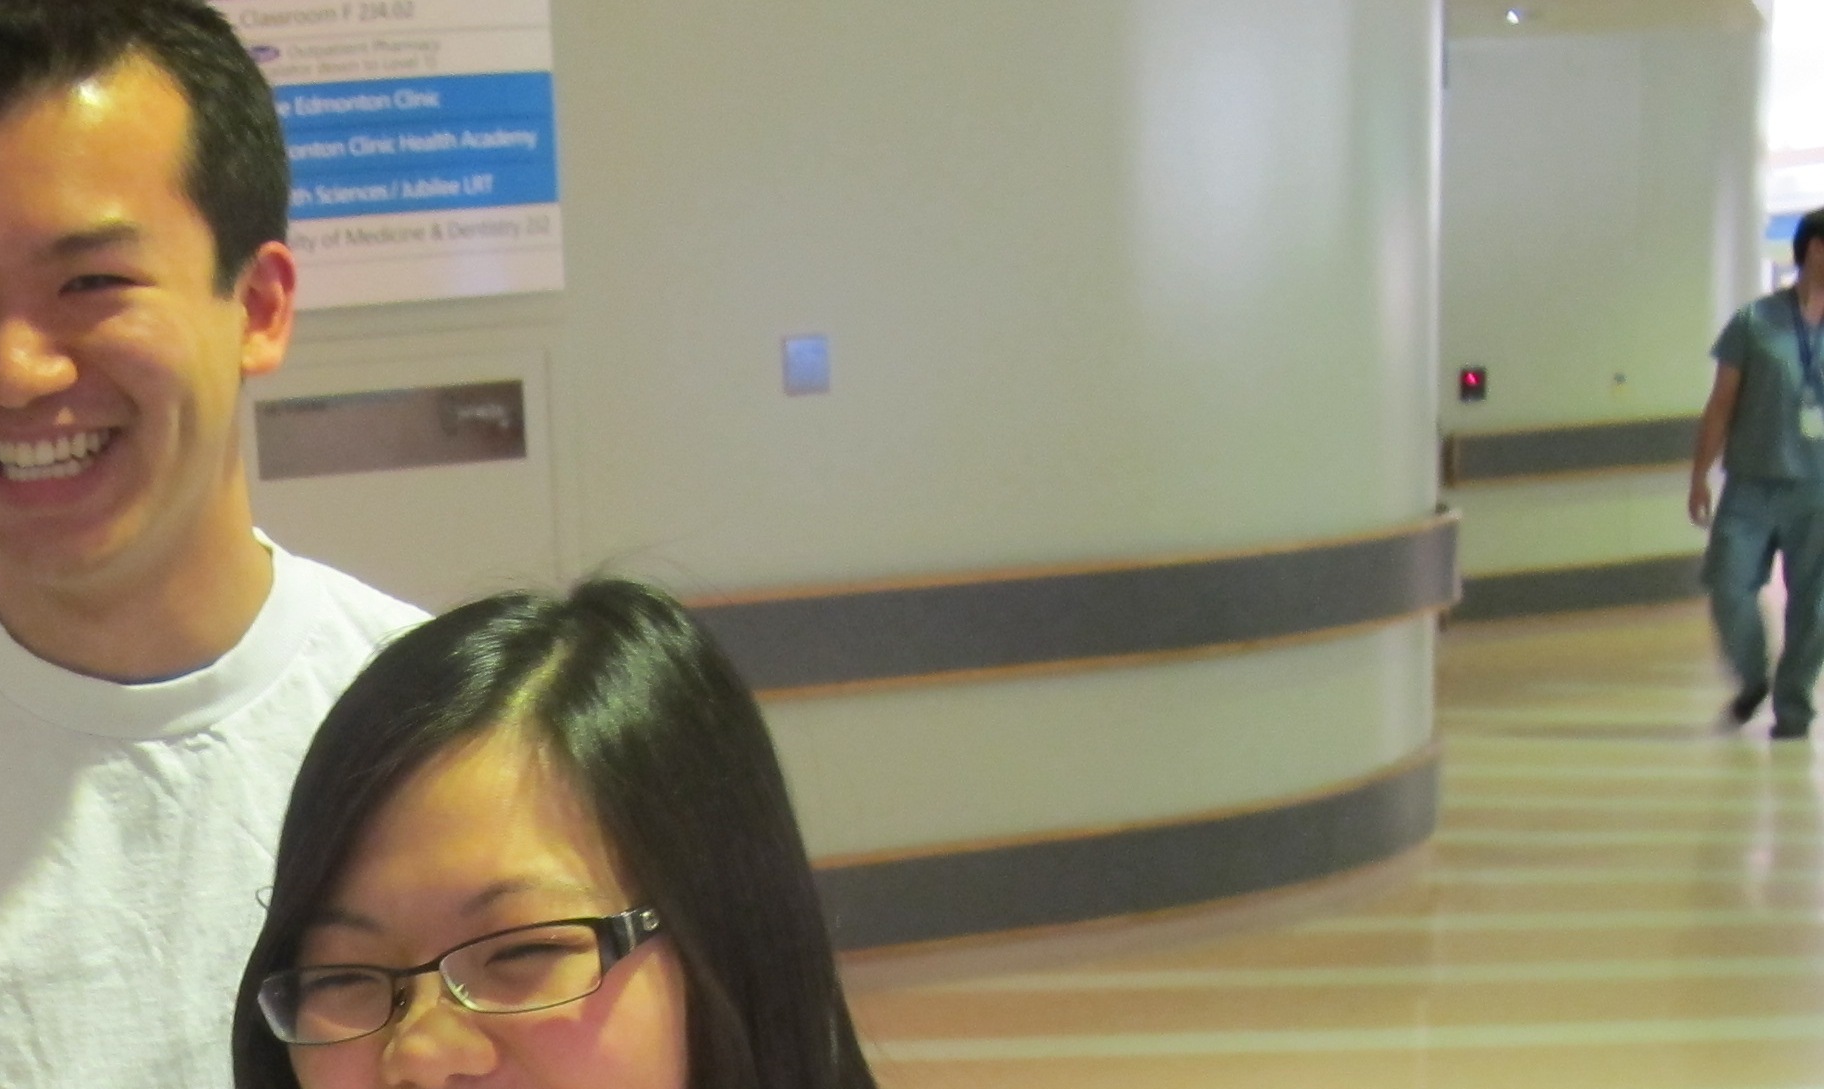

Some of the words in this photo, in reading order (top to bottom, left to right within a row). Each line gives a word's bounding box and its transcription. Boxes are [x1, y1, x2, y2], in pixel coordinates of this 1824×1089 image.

[294, 93, 391, 116] Edmonton
[393, 88, 440, 110] Clinic
[347, 135, 395, 157] Clinic
[397, 131, 457, 153] Health
[460, 129, 537, 152] Academy
[314, 183, 387, 206] Sciences
[345, 225, 426, 246] Medicine
[446, 217, 520, 241] Dentistry
